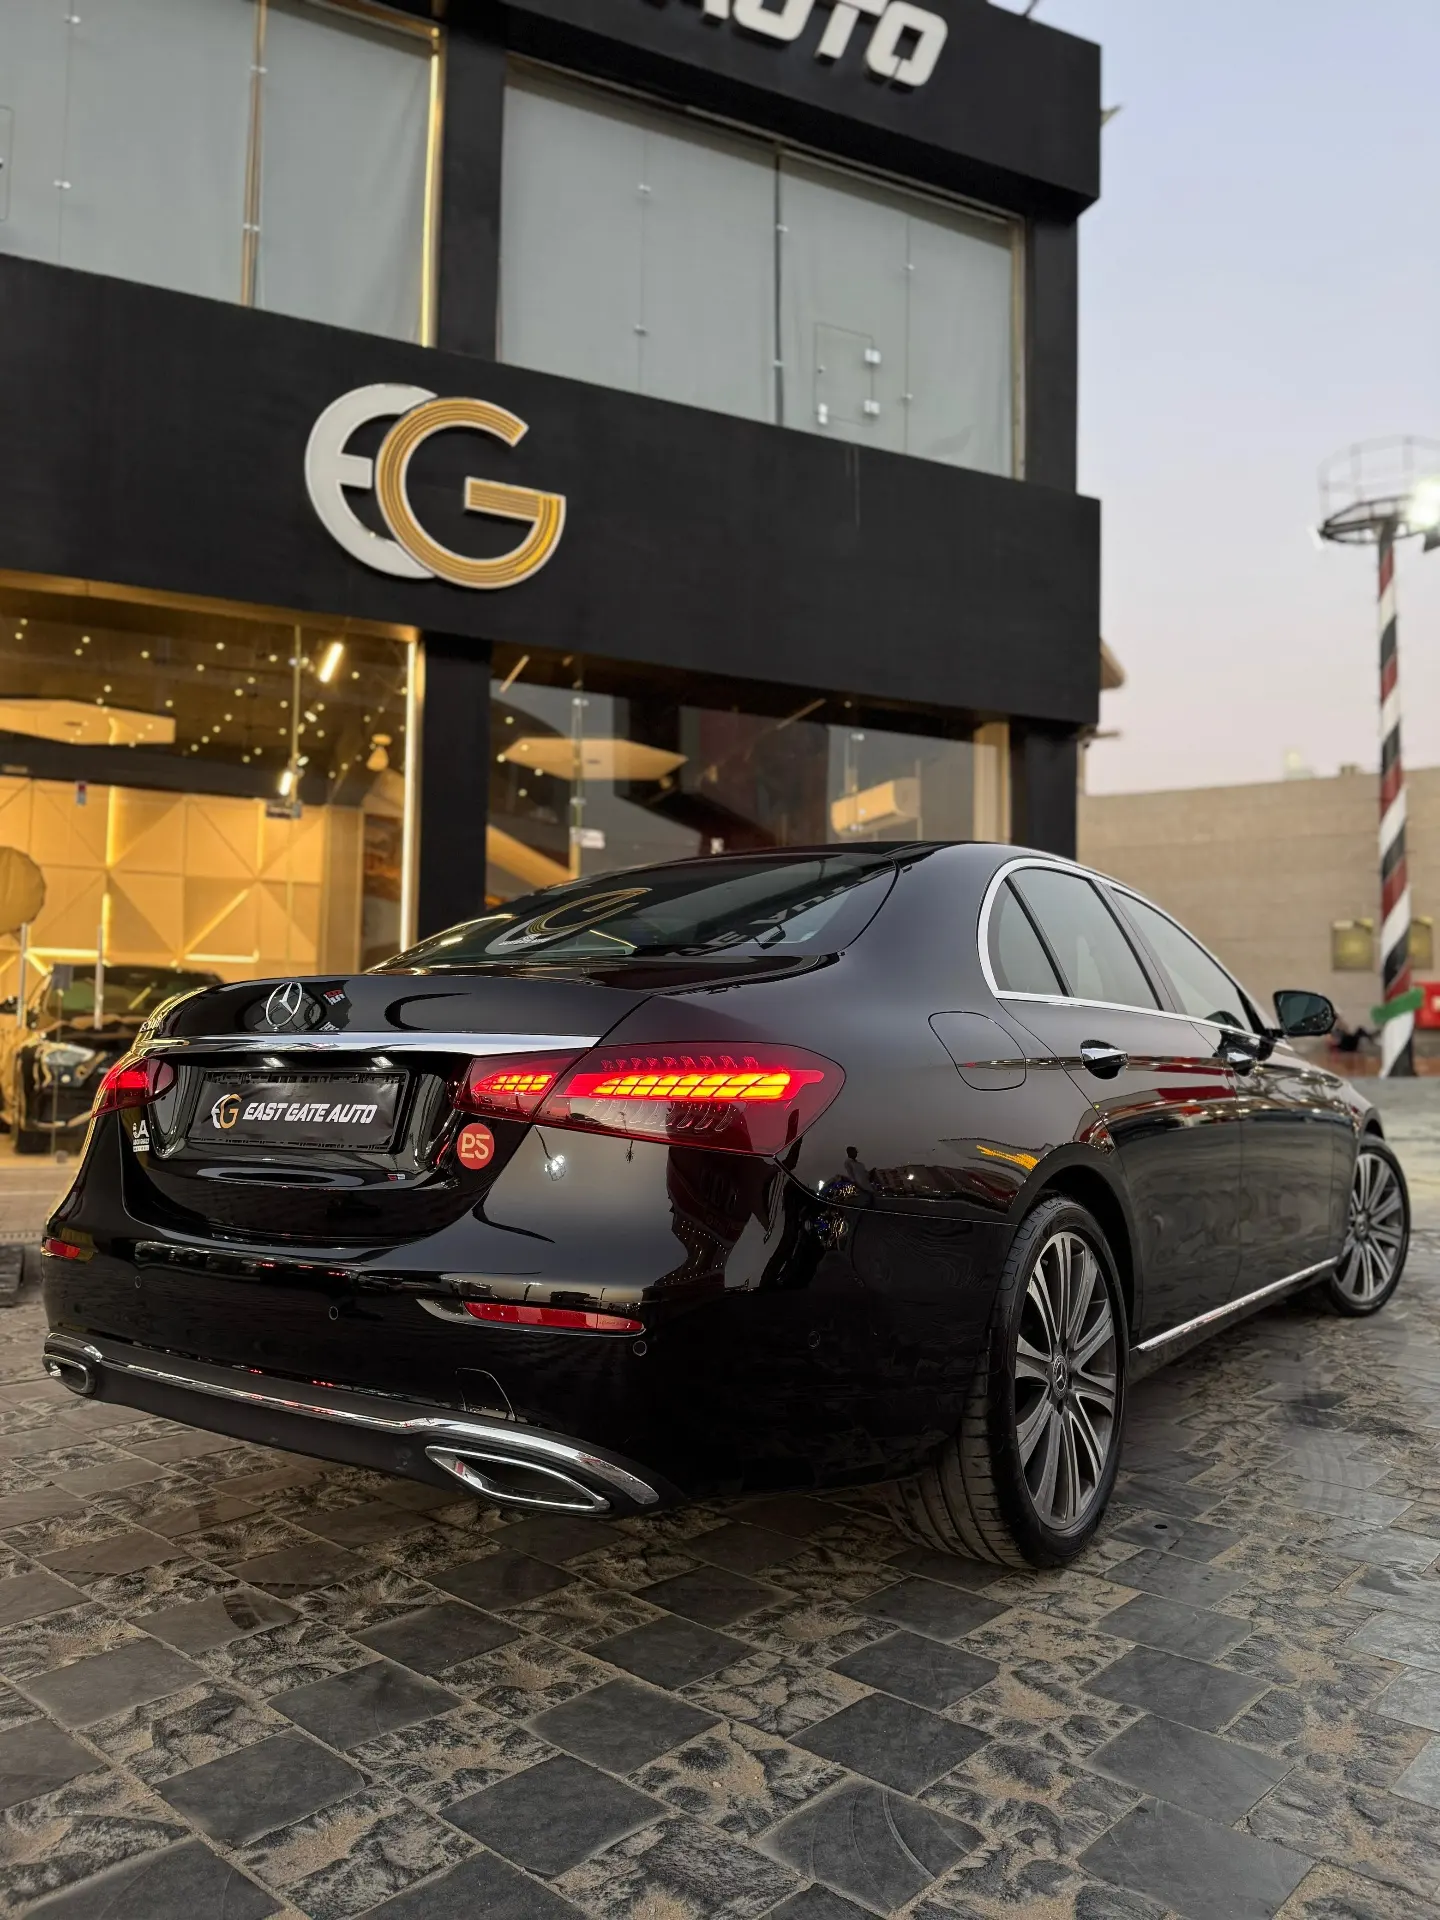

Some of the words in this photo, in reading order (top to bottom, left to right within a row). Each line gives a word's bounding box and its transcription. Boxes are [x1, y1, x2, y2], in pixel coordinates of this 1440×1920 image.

[703, 0, 948, 87] UTO
[305, 382, 567, 589] EG
[242, 1102, 288, 1121] EAST
[284, 1103, 328, 1123] GATE
[325, 1104, 379, 1124] AUTO
